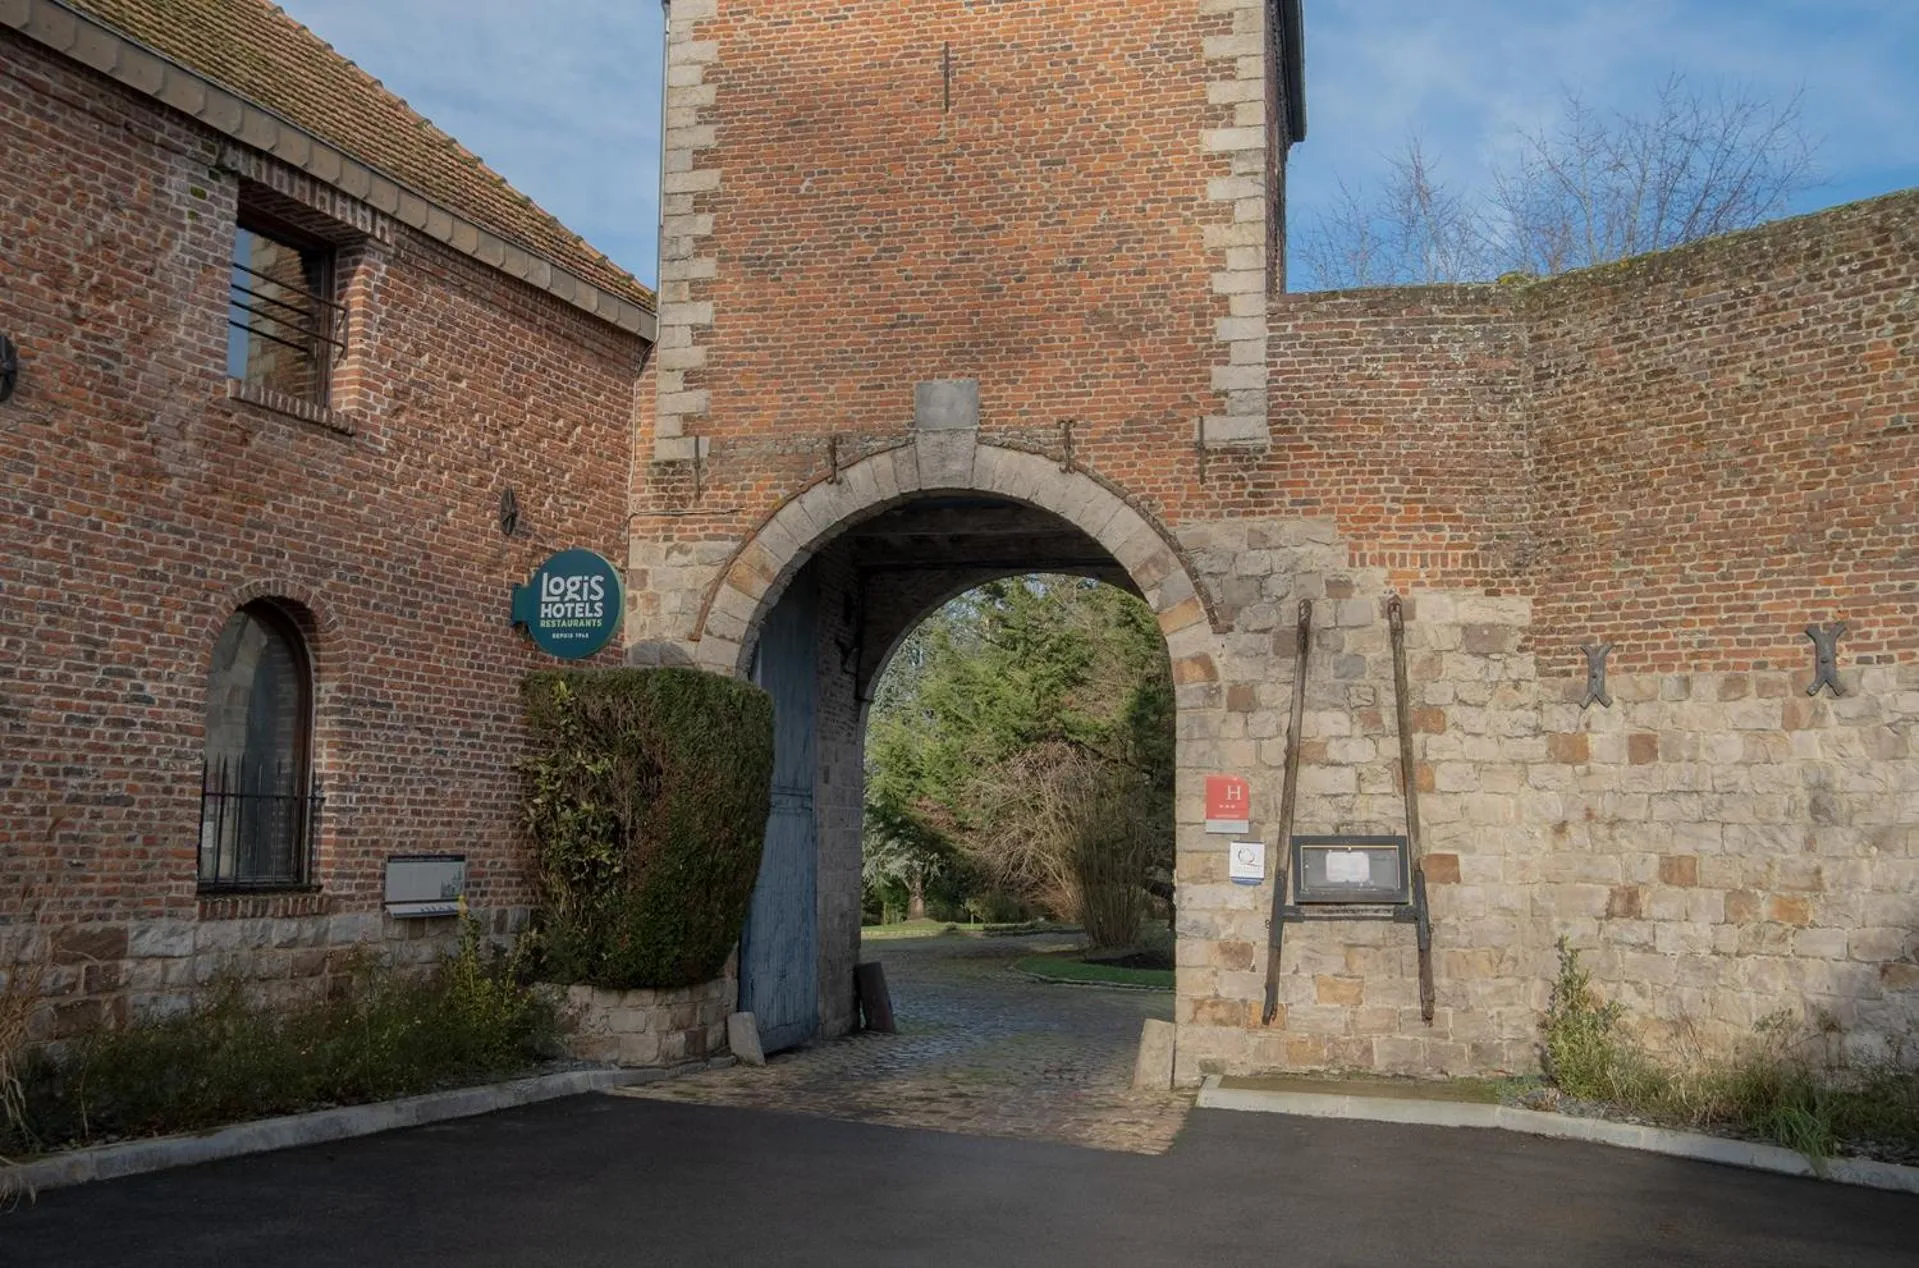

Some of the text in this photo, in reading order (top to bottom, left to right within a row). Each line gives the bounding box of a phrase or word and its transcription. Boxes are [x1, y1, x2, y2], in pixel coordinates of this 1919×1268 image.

[540, 602, 604, 618] HOTELS
[540, 619, 602, 628] RESTAURANTS
[1227, 784, 1241, 801] H
